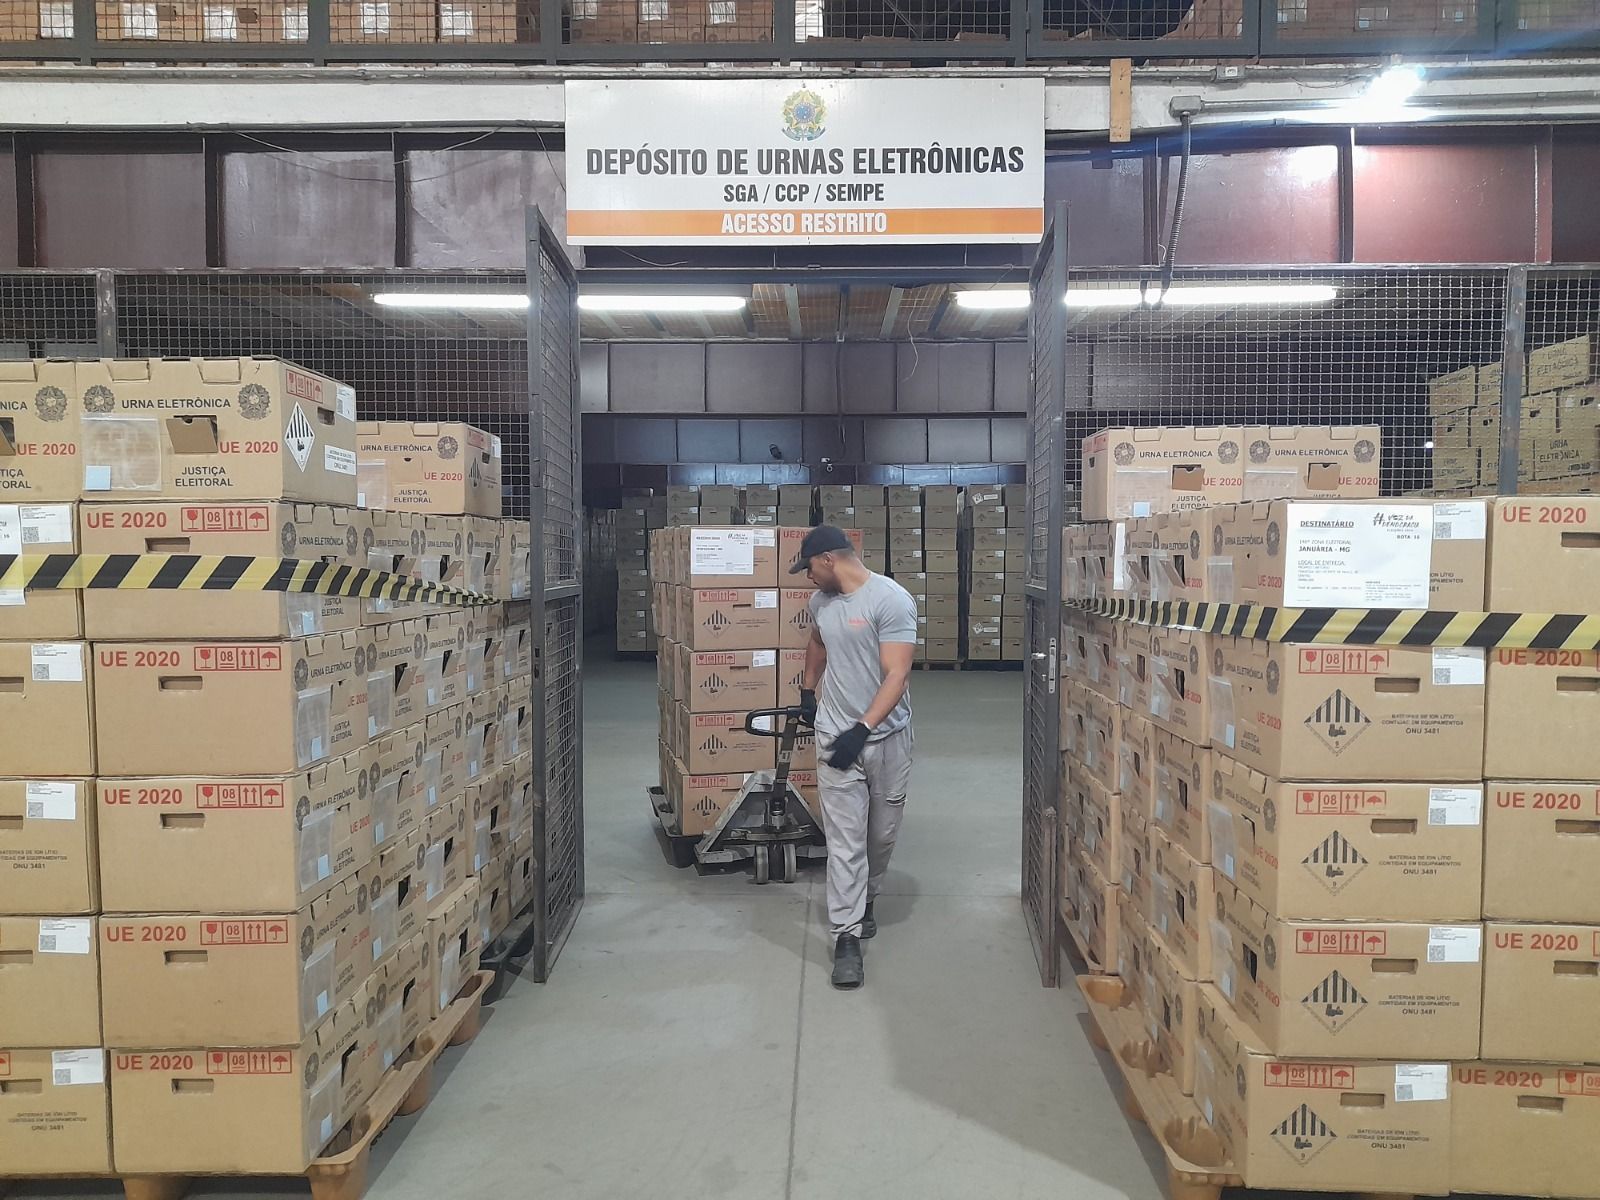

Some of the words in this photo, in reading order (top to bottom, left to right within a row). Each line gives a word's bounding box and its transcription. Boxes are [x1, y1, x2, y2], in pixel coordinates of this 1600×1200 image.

[586, 144, 708, 176] DEPÓSITO
[717, 148, 748, 176] DE
[757, 148, 845, 176] URNAS
[853, 143, 1025, 175] ELETRÔNICAS
[723, 184, 759, 203] SGA
[762, 184, 770, 204] /
[774, 184, 810, 202] CCP
[813, 184, 822, 204] /
[825, 183, 885, 202] SEMPE
[721, 213, 794, 235] ACESSO
[801, 212, 887, 234] RESTRITO
[121, 399, 153, 409] URNA
[157, 397, 232, 409] ELETRÔNICA
[17, 443, 38, 456] UE
[42, 443, 76, 456] 2020
[220, 441, 240, 453] UE
[245, 440, 279, 453] 2020
[360, 444, 382, 452] URNA
[384, 443, 433, 452] ELETRÔNICA
[1299, 447, 1348, 456] ELETRÔNICA
[1139, 450, 1161, 458] URNA
[1163, 449, 1213, 458] ELETRÔNICA
[182, 466, 226, 477] JUSTIÇA
[423, 472, 437, 481] UE
[440, 472, 463, 481] 2020
[175, 477, 234, 488] ELEITORAL
[1202, 477, 1216, 486] UE
[1219, 477, 1242, 486] 2020
[1338, 477, 1352, 485] UE
[1355, 477, 1378, 485] 2020
[393, 496, 432, 504] ELEITORAL
[87, 512, 114, 529] UE
[121, 512, 167, 528] 2020
[1503, 506, 1531, 523] UE
[1538, 506, 1587, 524] 2020
[1300, 519, 1355, 528] DESTINATÁRIO
[1298, 545, 1333, 553] JANUÁRIA
[100, 651, 128, 667] UE
[134, 650, 180, 667] 2020
[1499, 649, 1528, 666] UE
[1535, 650, 1582, 667] 2020
[103, 789, 131, 805] UE
[137, 788, 183, 805] 2020
[1496, 791, 1524, 808] UE
[1532, 792, 1581, 810] 2020
[106, 926, 134, 942] UE
[141, 925, 187, 942] 2020
[226, 925, 240, 936] 08
[1323, 934, 1337, 945] 08
[1495, 932, 1523, 949] UE
[1530, 933, 1579, 951] 2020
[116, 1055, 143, 1070] UE
[150, 1054, 194, 1070] 2020
[231, 1055, 246, 1066] 08
[1458, 1068, 1487, 1085] UE
[1494, 1070, 1543, 1089] 2020
